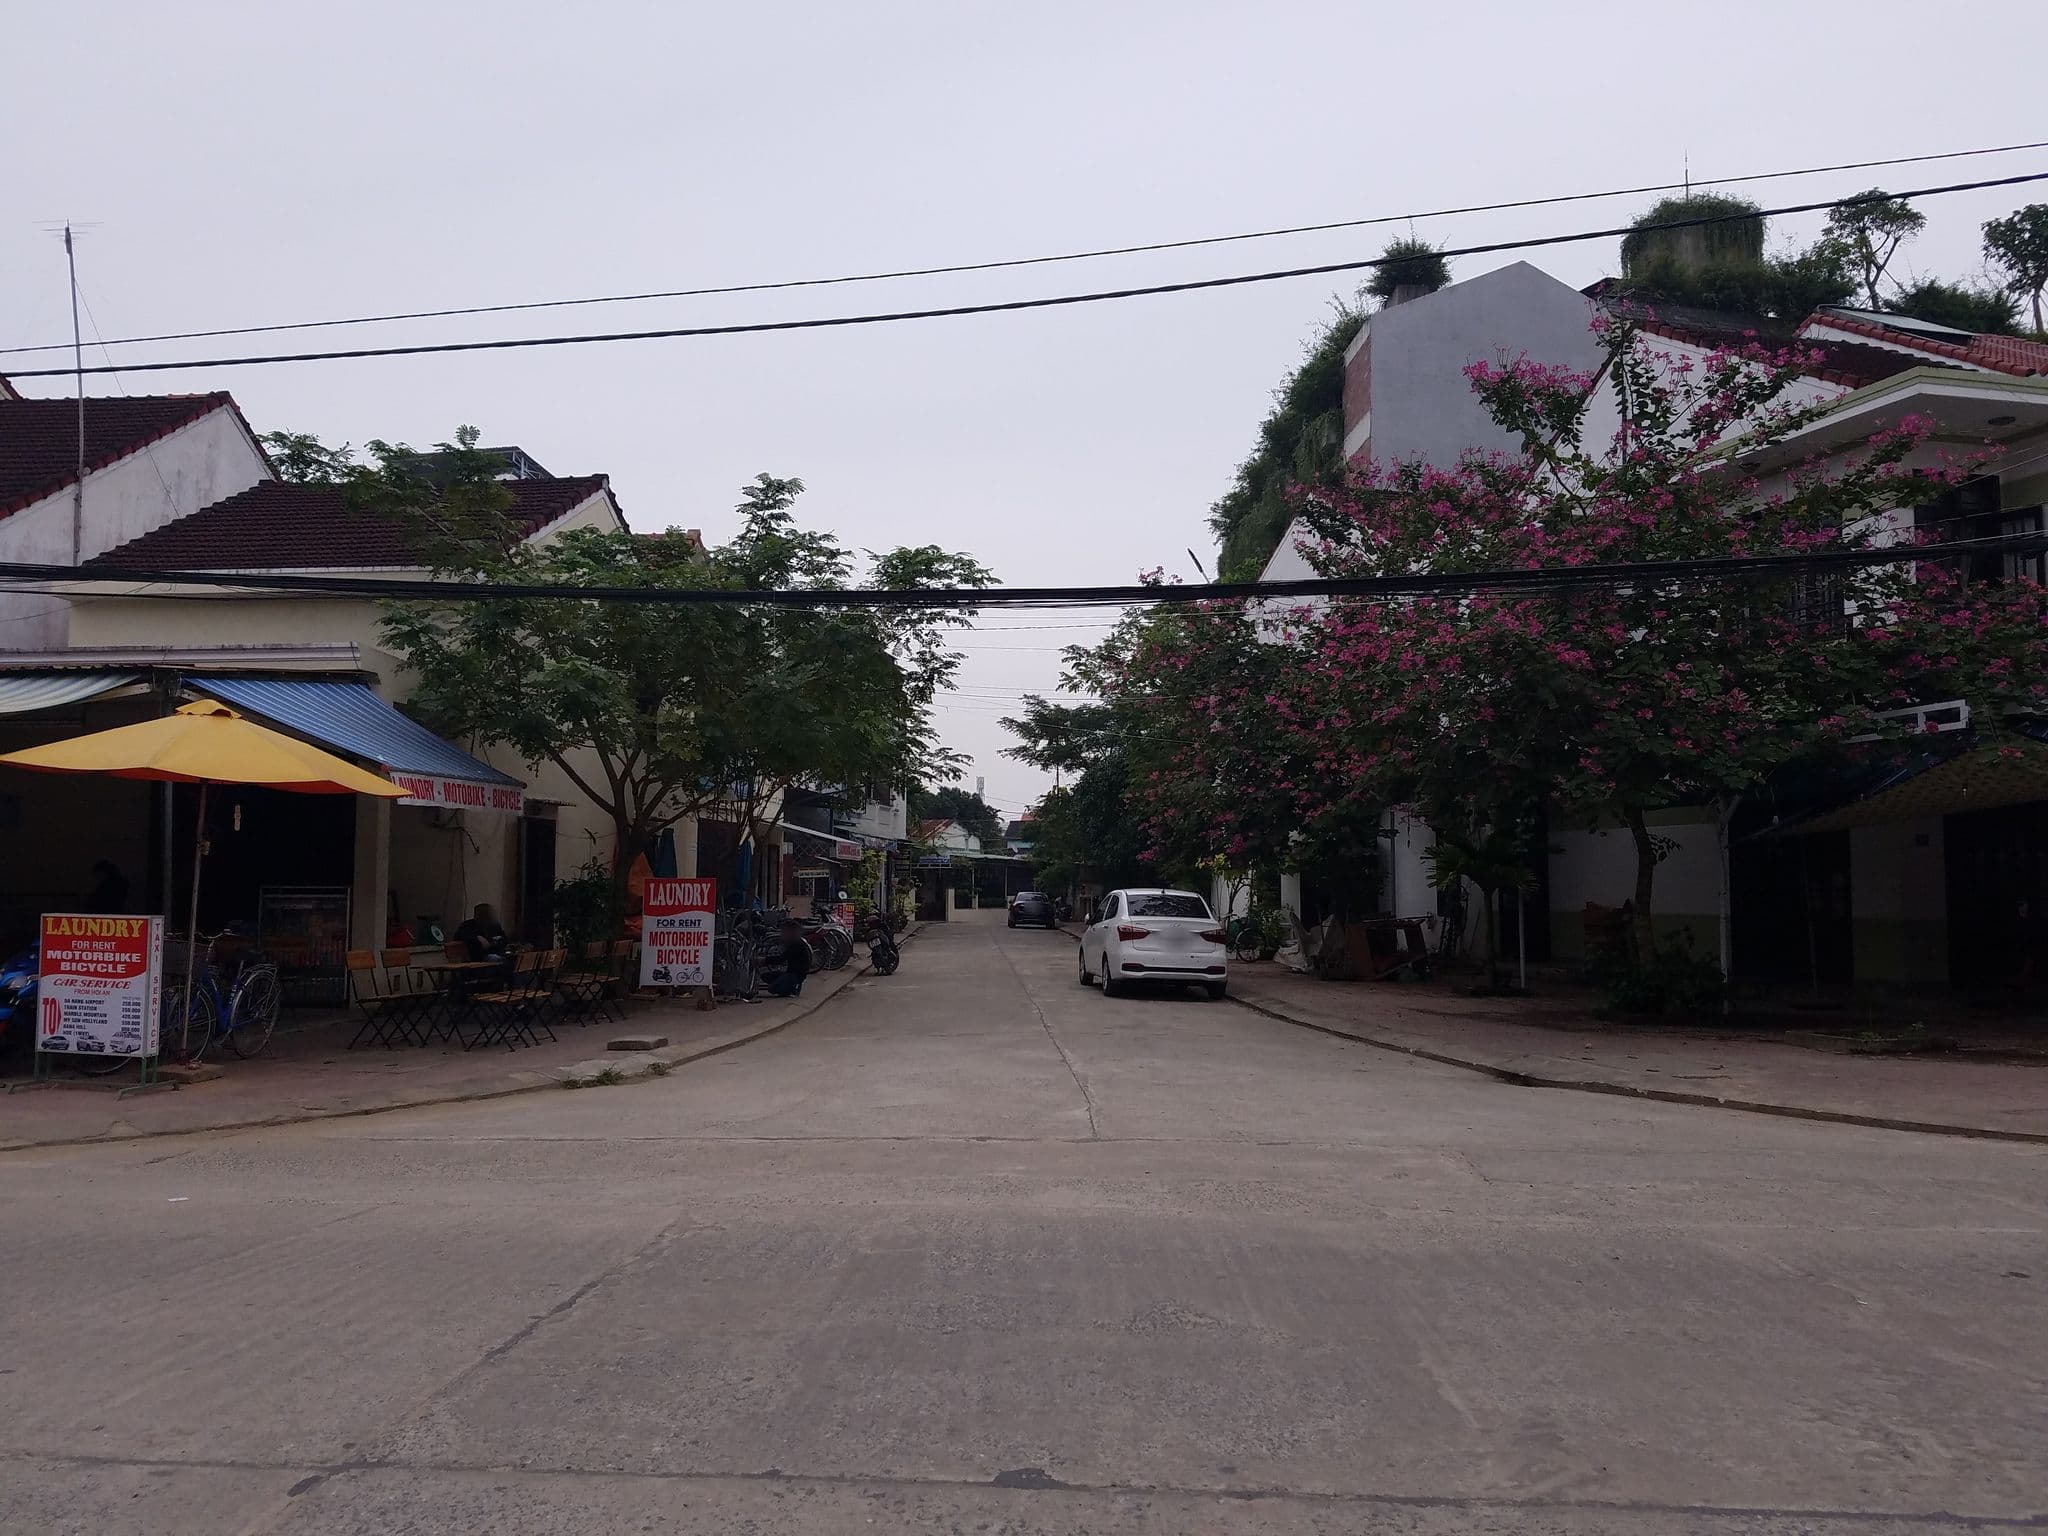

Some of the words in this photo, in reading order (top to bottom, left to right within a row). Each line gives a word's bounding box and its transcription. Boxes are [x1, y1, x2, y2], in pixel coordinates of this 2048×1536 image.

[443, 782, 486, 807] MOTOBIKE
[492, 788, 522, 811] BICYCLE
[649, 882, 711, 906] LAUNDRY
[46, 917, 144, 938] LAUNDRY
[656, 919, 675, 927] FOR
[678, 919, 702, 927] RENT
[71, 940, 92, 950] FOR
[92, 941, 117, 951] RENT
[648, 931, 709, 947] MOTORBIKE
[46, 950, 141, 963] MOTORBIKE
[656, 949, 700, 965] BICYCLE
[60, 962, 126, 973] BICYCLE
[53, 978, 78, 987] CAR
[79, 979, 132, 990] SERVICE
[42, 997, 57, 1036] TO
[150, 976, 159, 1049] SERVICE
